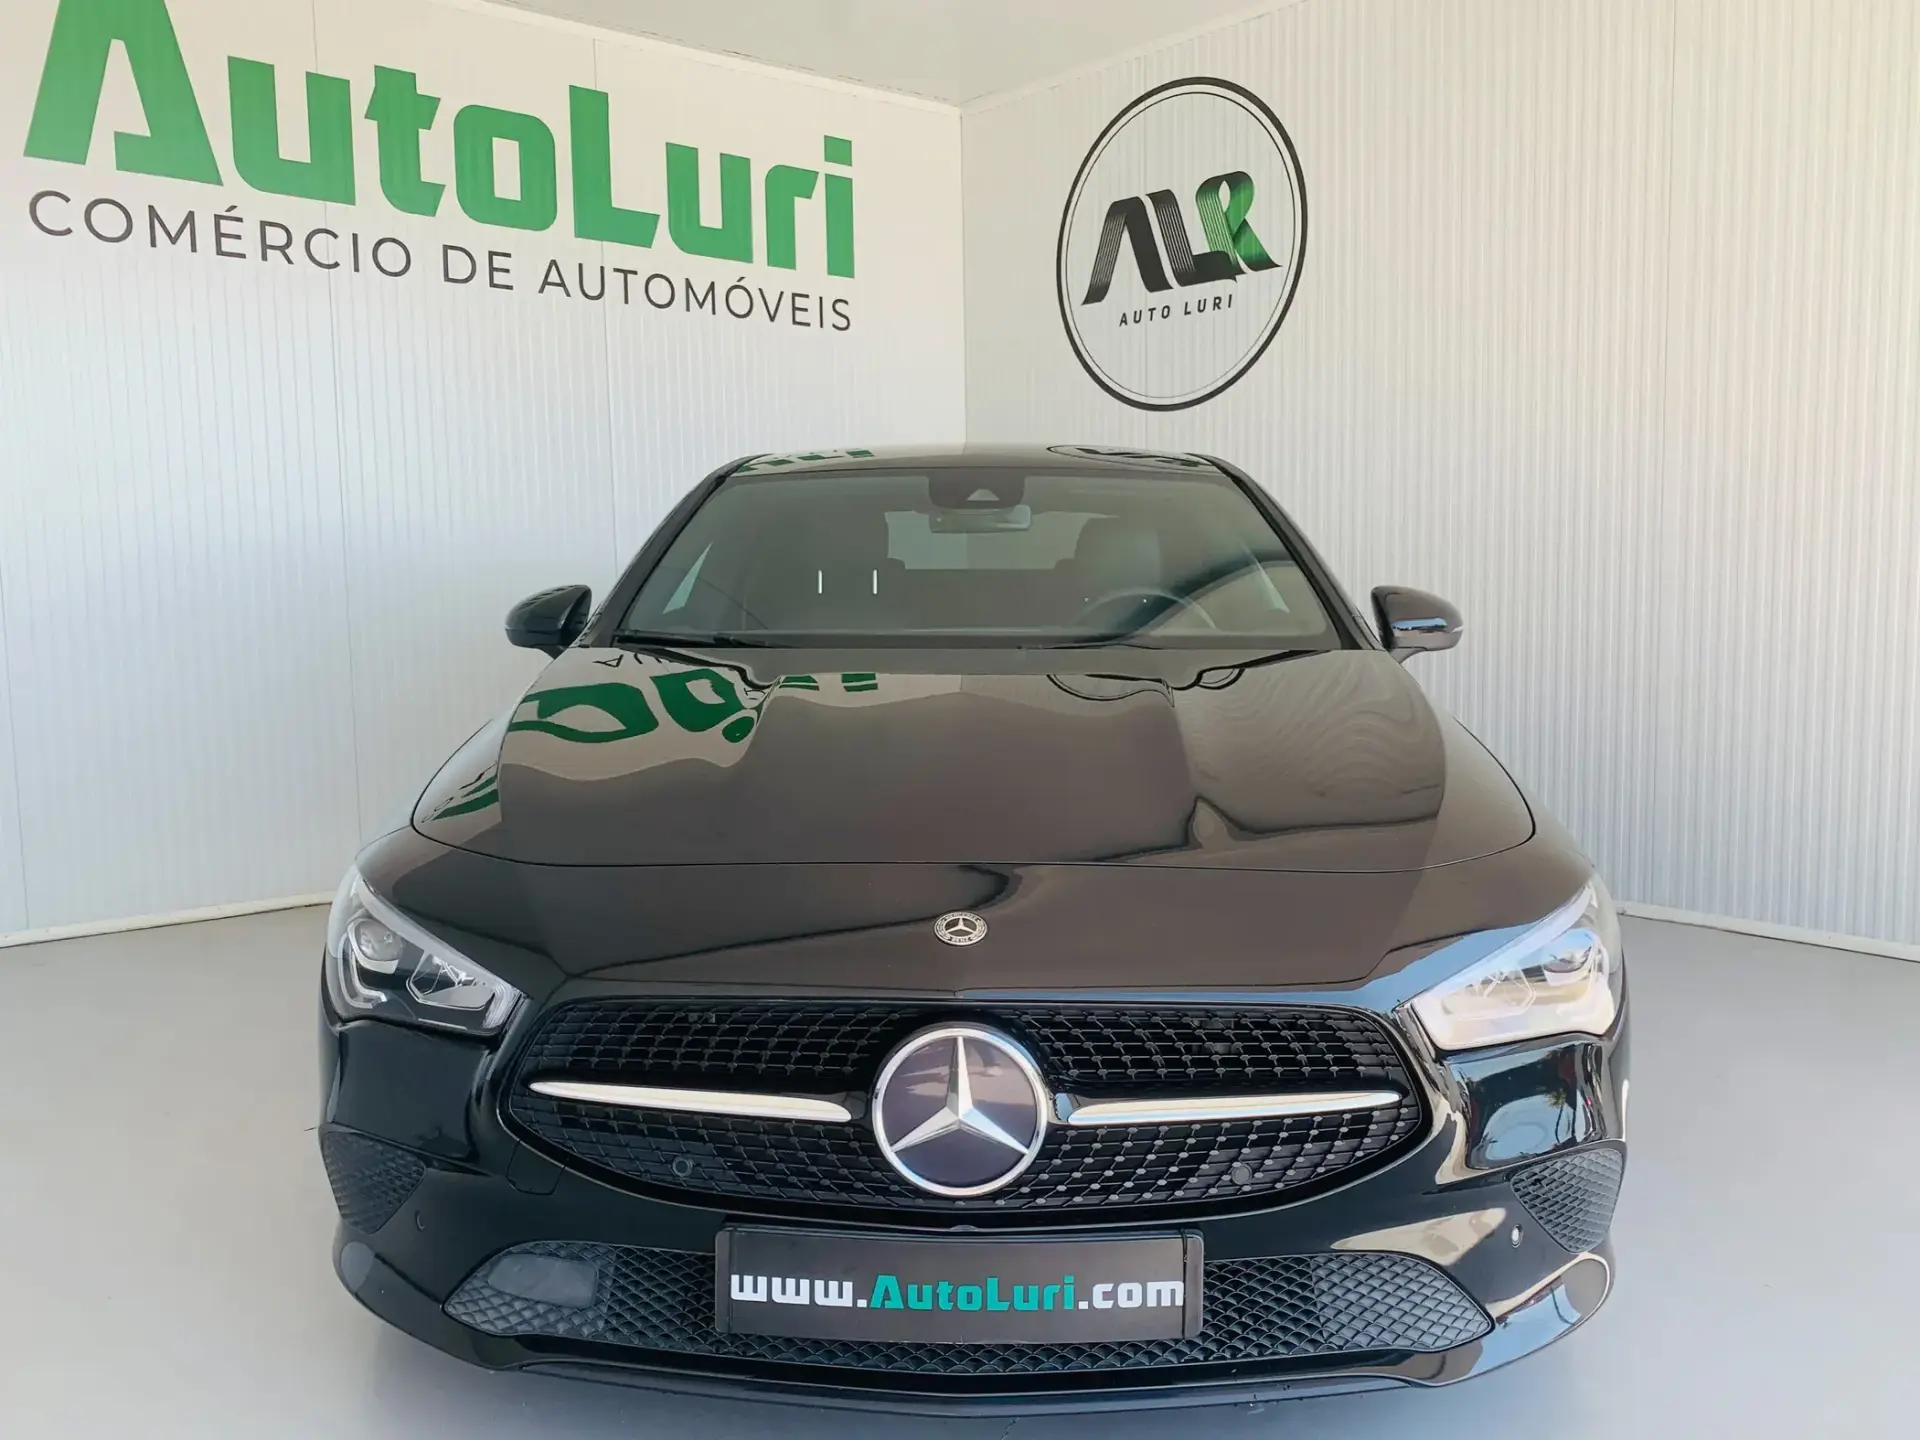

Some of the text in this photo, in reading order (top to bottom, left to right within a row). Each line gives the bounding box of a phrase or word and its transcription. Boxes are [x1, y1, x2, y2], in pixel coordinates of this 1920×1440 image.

[23, 0, 855, 279] AutoLuri
[28, 190, 853, 332] COMÉRCIO DE AUTOMÓVEIS
[1119, 294, 1233, 327] AUTO LURI
[731, 1274, 1185, 1311] www.AutoLuri.com
